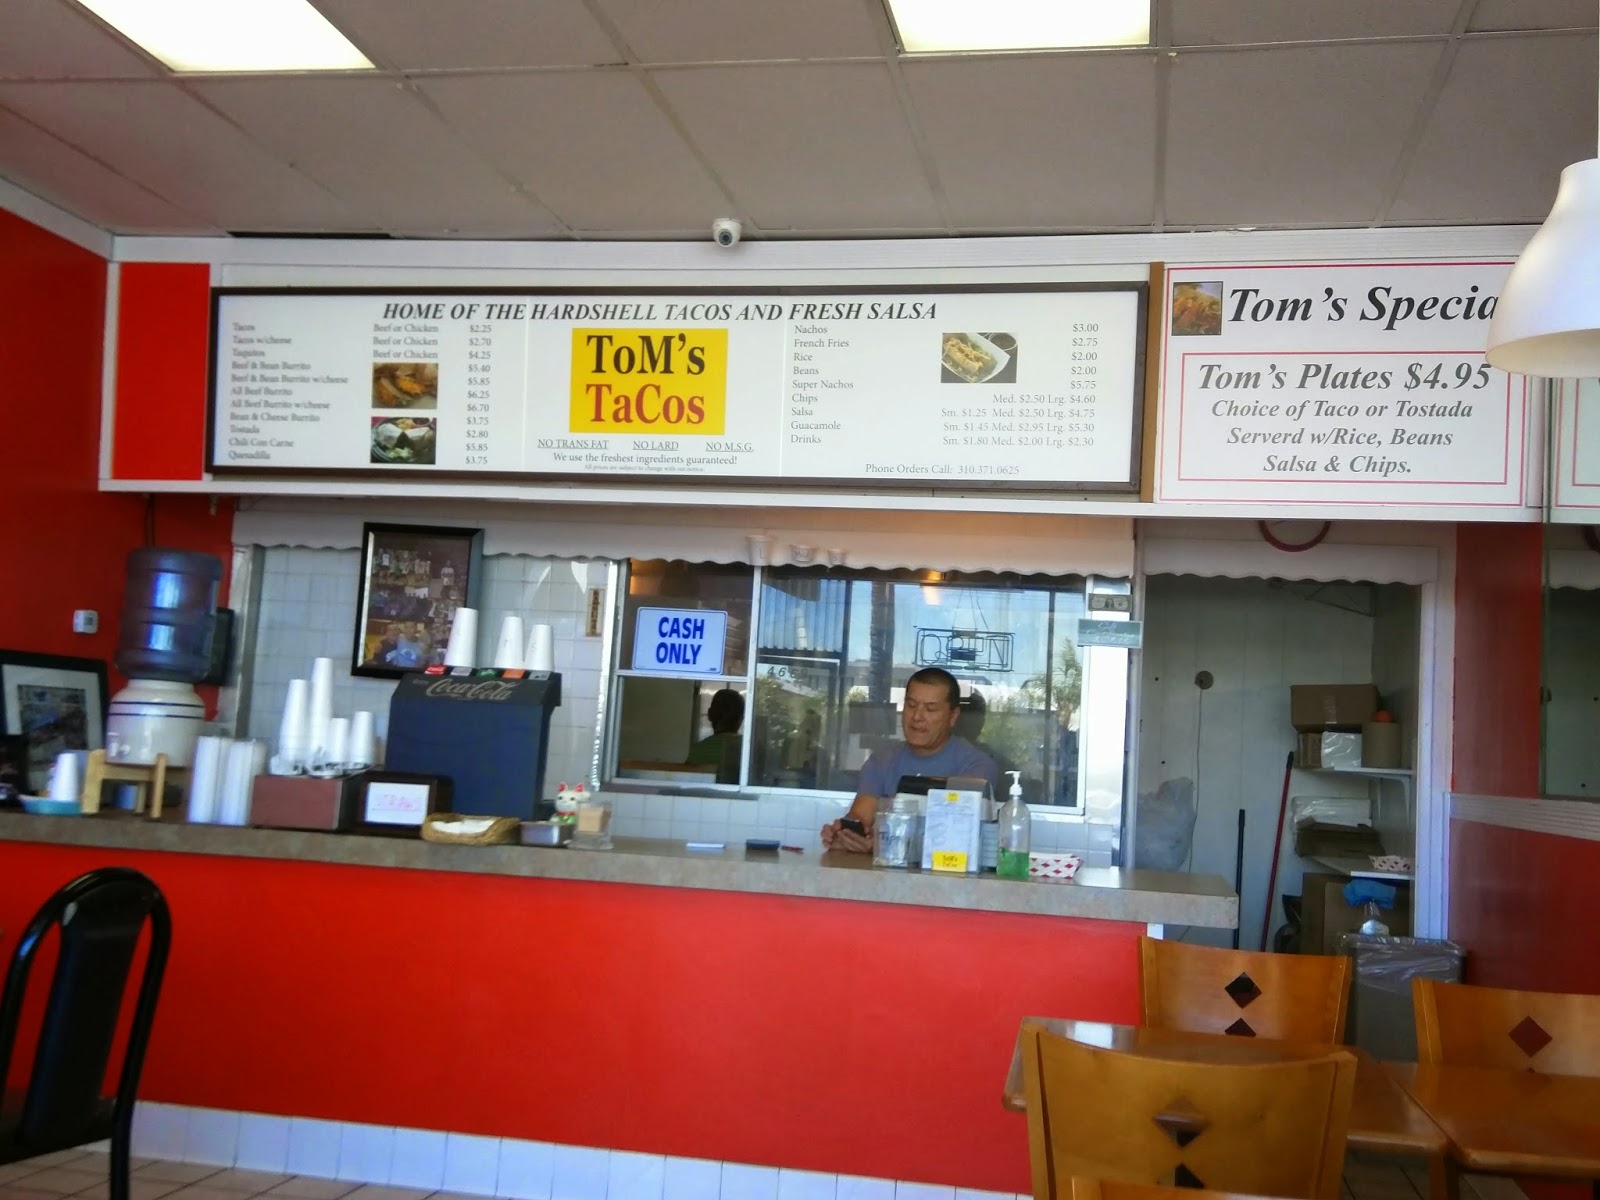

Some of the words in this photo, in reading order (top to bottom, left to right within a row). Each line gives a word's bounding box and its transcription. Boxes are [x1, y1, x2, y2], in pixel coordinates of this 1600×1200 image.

[382, 302, 446, 320] HOME
[450, 302, 480, 320] OF
[485, 302, 526, 320] THE
[530, 303, 658, 320] HARDSHELL
[664, 303, 732, 321] TACOS
[735, 303, 783, 321] AND
[788, 302, 863, 320] FRESH
[867, 302, 937, 320] SALSA
[1228, 287, 1348, 322] Tom's
[1359, 285, 1498, 330] Specia
[373, 323, 391, 333] Beef
[393, 325, 402, 333] or
[404, 323, 439, 333] Chicken
[470, 324, 492, 333] $2.25
[795, 325, 828, 334] Nachos
[1073, 323, 1099, 333] $3.00
[372, 336, 391, 346] Beef
[393, 338, 402, 346] or
[403, 336, 439, 346] Chicken
[469, 338, 492, 346] $2.70
[794, 338, 825, 348] French
[828, 338, 849, 348] Fries
[1072, 337, 1098, 347] $2.75
[372, 349, 391, 359] Beef
[393, 351, 402, 359] or
[403, 349, 439, 359] Chicken
[469, 351, 491, 359] $4.25
[586, 333, 706, 375] ToM's
[794, 352, 813, 361] Rice
[1071, 352, 1098, 361] $2.00
[468, 364, 491, 373] $5.40
[793, 366, 819, 375] Beans
[1071, 366, 1097, 376] $2.00
[468, 377, 490, 386] $5.85
[1199, 363, 1287, 391] Tom's
[1295, 362, 1393, 391] Plates
[1404, 362, 1491, 391] $4.95
[792, 380, 818, 391] Super
[821, 380, 854, 389] Nachos
[1070, 380, 1096, 390] $5.75
[467, 390, 490, 399] $6.25
[792, 393, 818, 405] Chips
[586, 383, 705, 425] TaCos
[993, 394, 1016, 404] Med.
[1020, 394, 1045, 404] $2.50
[1048, 395, 1067, 406] Lrg.
[1070, 394, 1096, 404] $4.60
[467, 404, 490, 412] $6.70
[792, 407, 813, 416] Salsa
[1211, 400, 1280, 417] Choice
[1286, 400, 1310, 421] of
[1314, 400, 1359, 417] Taco
[1366, 404, 1389, 417] or
[1396, 400, 1473, 417] Tostada
[941, 408, 958, 418] Sm.
[962, 408, 987, 418] $1.25
[993, 408, 1016, 418] Med.
[1019, 408, 1044, 418] $2.50
[1048, 409, 1066, 420] Lrg.
[1069, 408, 1095, 418] $4.75
[466, 417, 489, 425] $3.75
[791, 421, 841, 430] Guacamole
[944, 422, 961, 432] Sm.
[964, 422, 989, 432] $1.45
[992, 422, 1015, 432] Med.
[1019, 422, 1044, 432] $2.95
[1047, 423, 1065, 434] Lrg.
[1069, 422, 1094, 432] $5.30
[466, 430, 489, 439] $2.80
[791, 434, 822, 443] Drinks
[1227, 427, 1303, 446] Serverd
[1310, 427, 1382, 448] w/Rice,
[1389, 427, 1454, 446] Beans
[466, 443, 488, 452] $5.85
[538, 439, 554, 450] NO
[556, 439, 589, 450] TRANS
[591, 439, 609, 450] FAT
[633, 440, 649, 451] NO
[652, 440, 679, 451] LARD
[706, 442, 722, 452] NO
[724, 442, 754, 452] M.S.G.
[943, 436, 960, 446] Sm.
[964, 436, 988, 446] $1.80
[991, 436, 1015, 446] Med.
[1018, 436, 1043, 446] $2.00
[1047, 437, 1065, 449] Lrg.
[1068, 436, 1094, 446] $2.30
[465, 456, 488, 465] $3.75
[553, 453, 567, 461] We
[586, 453, 599, 462] the
[601, 453, 634, 463] freshest
[636, 454, 684, 466] ingredients
[686, 455, 737, 466] guaranteed!
[866, 463, 894, 473] Phone
[897, 464, 929, 474] Orders
[932, 464, 952, 474] Call:
[958, 465, 1020, 475] 310.371.0625
[1263, 455, 1316, 473] Salsa
[1324, 455, 1340, 473] &
[1349, 455, 1412, 477] Chips.
[658, 616, 705, 640] CASH
[656, 642, 702, 665] ONLY
